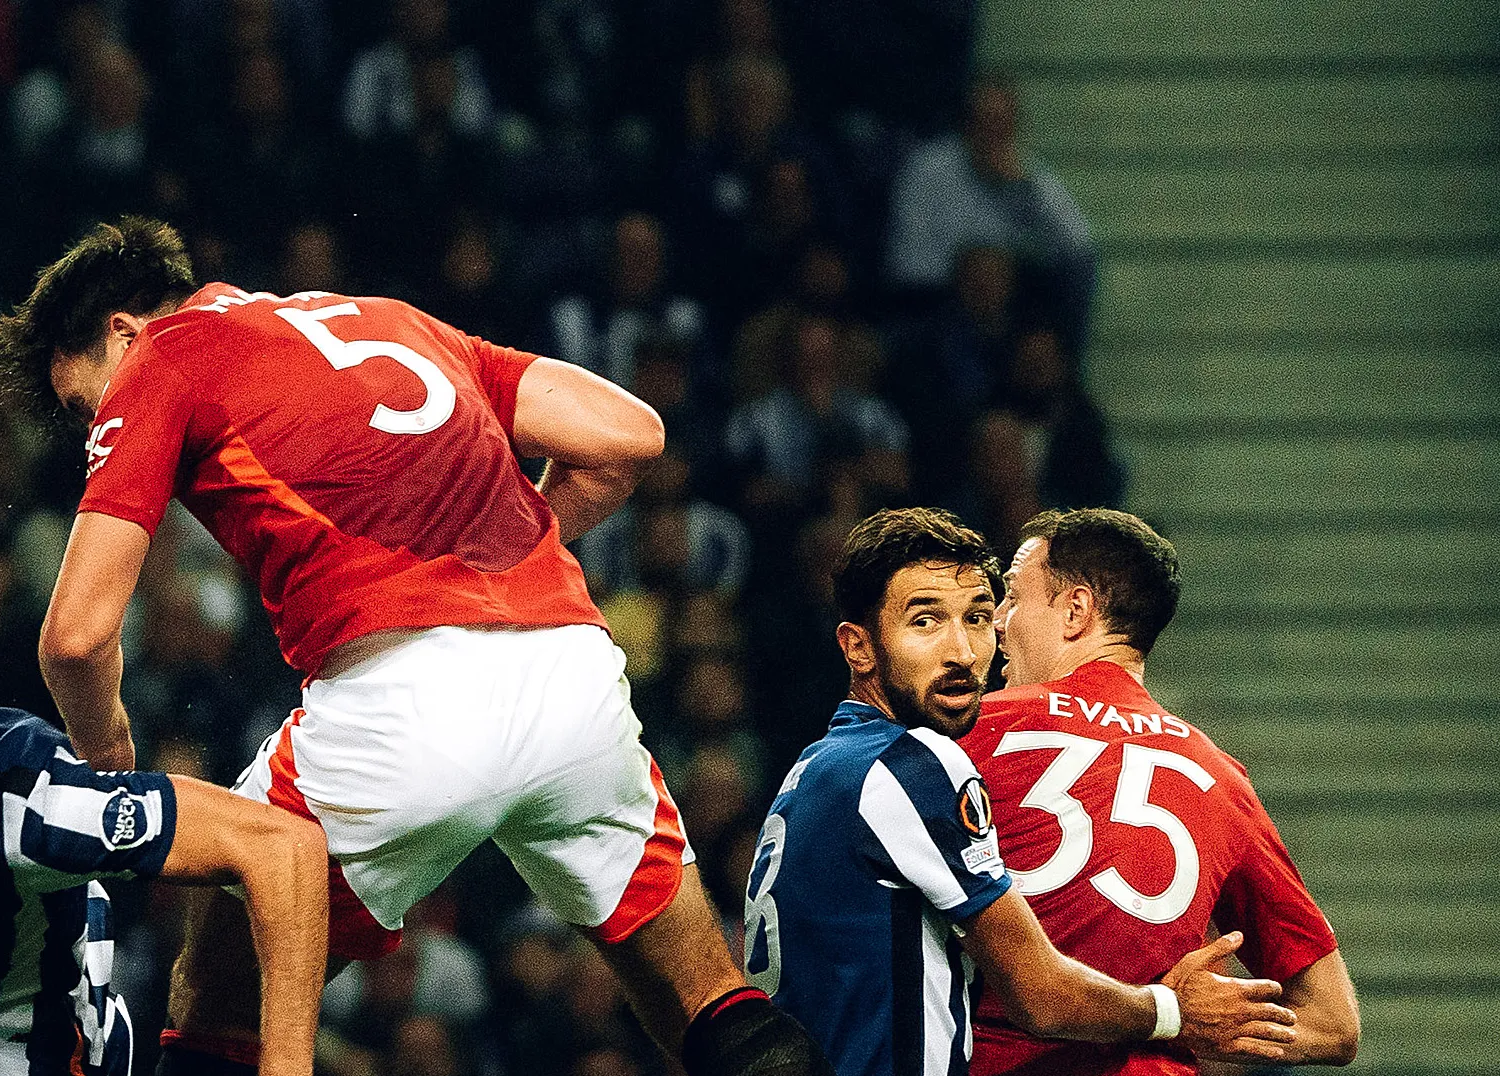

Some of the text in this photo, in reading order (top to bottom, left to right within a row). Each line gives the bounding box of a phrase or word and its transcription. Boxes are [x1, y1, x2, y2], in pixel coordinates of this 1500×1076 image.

[273, 302, 456, 434] 5
[1048, 692, 1191, 738] EVANS
[991, 730, 1217, 925] 35
